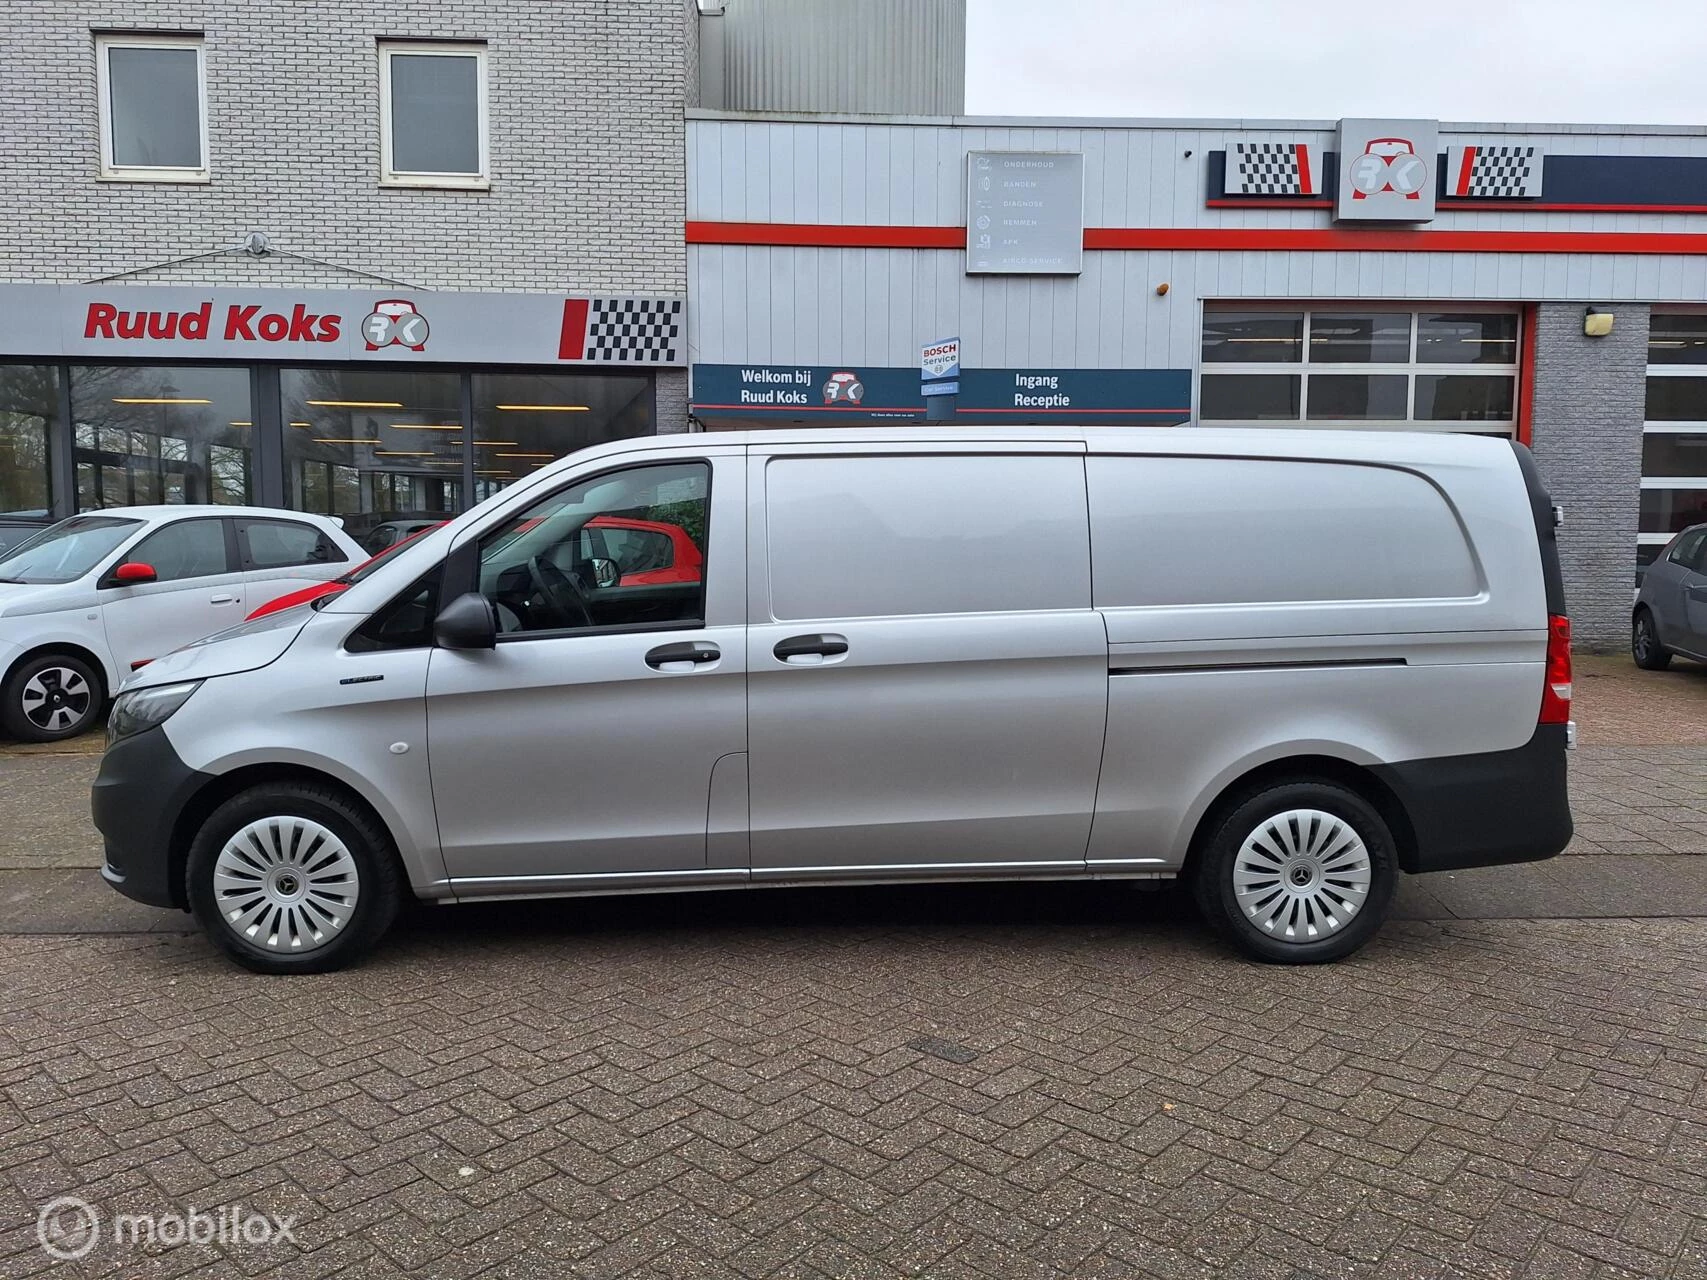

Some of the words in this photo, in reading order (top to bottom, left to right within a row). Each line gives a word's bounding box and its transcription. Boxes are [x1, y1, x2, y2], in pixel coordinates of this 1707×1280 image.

[84, 302, 213, 340] Ruud
[223, 304, 342, 343] Koks
[923, 344, 956, 357] BOSCH
[923, 355, 956, 366] Service
[741, 369, 792, 384] Welkom
[795, 370, 811, 387] bij
[1015, 373, 1058, 389] Ingang
[741, 389, 774, 403] Ruud
[776, 390, 808, 404] Koks
[1014, 393, 1070, 409] Receptie
